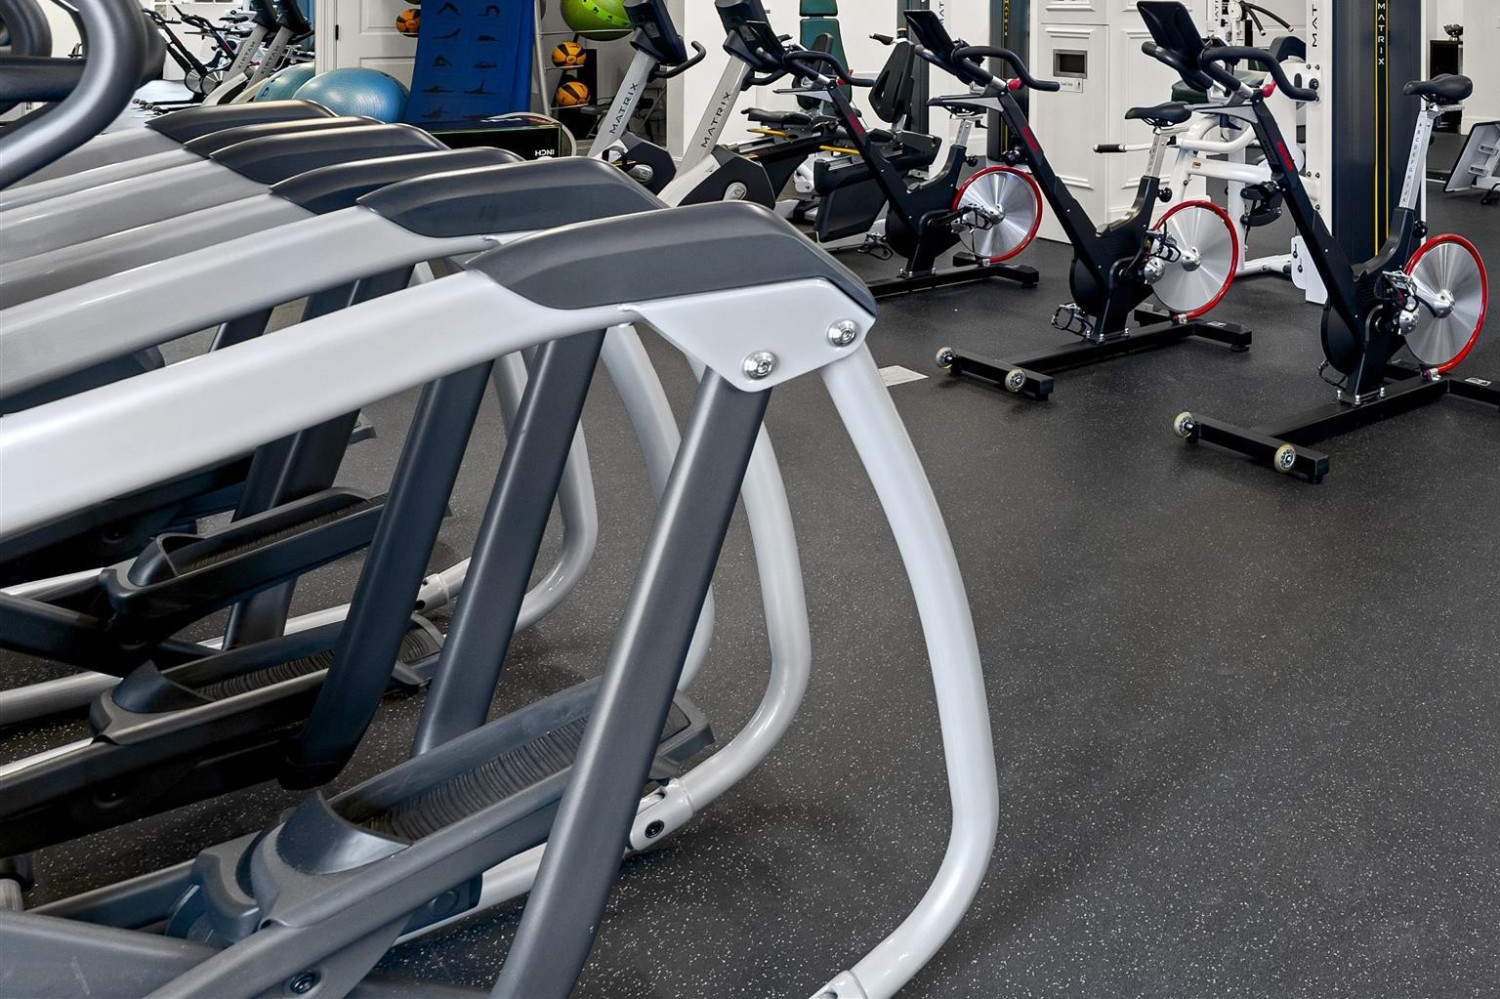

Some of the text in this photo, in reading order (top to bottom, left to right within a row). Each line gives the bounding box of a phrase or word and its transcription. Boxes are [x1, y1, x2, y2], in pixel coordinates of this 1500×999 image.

[1377, 3, 1386, 65] MATRIX
[609, 83, 639, 134] MATRIX
[701, 92, 731, 148] MATRIX
